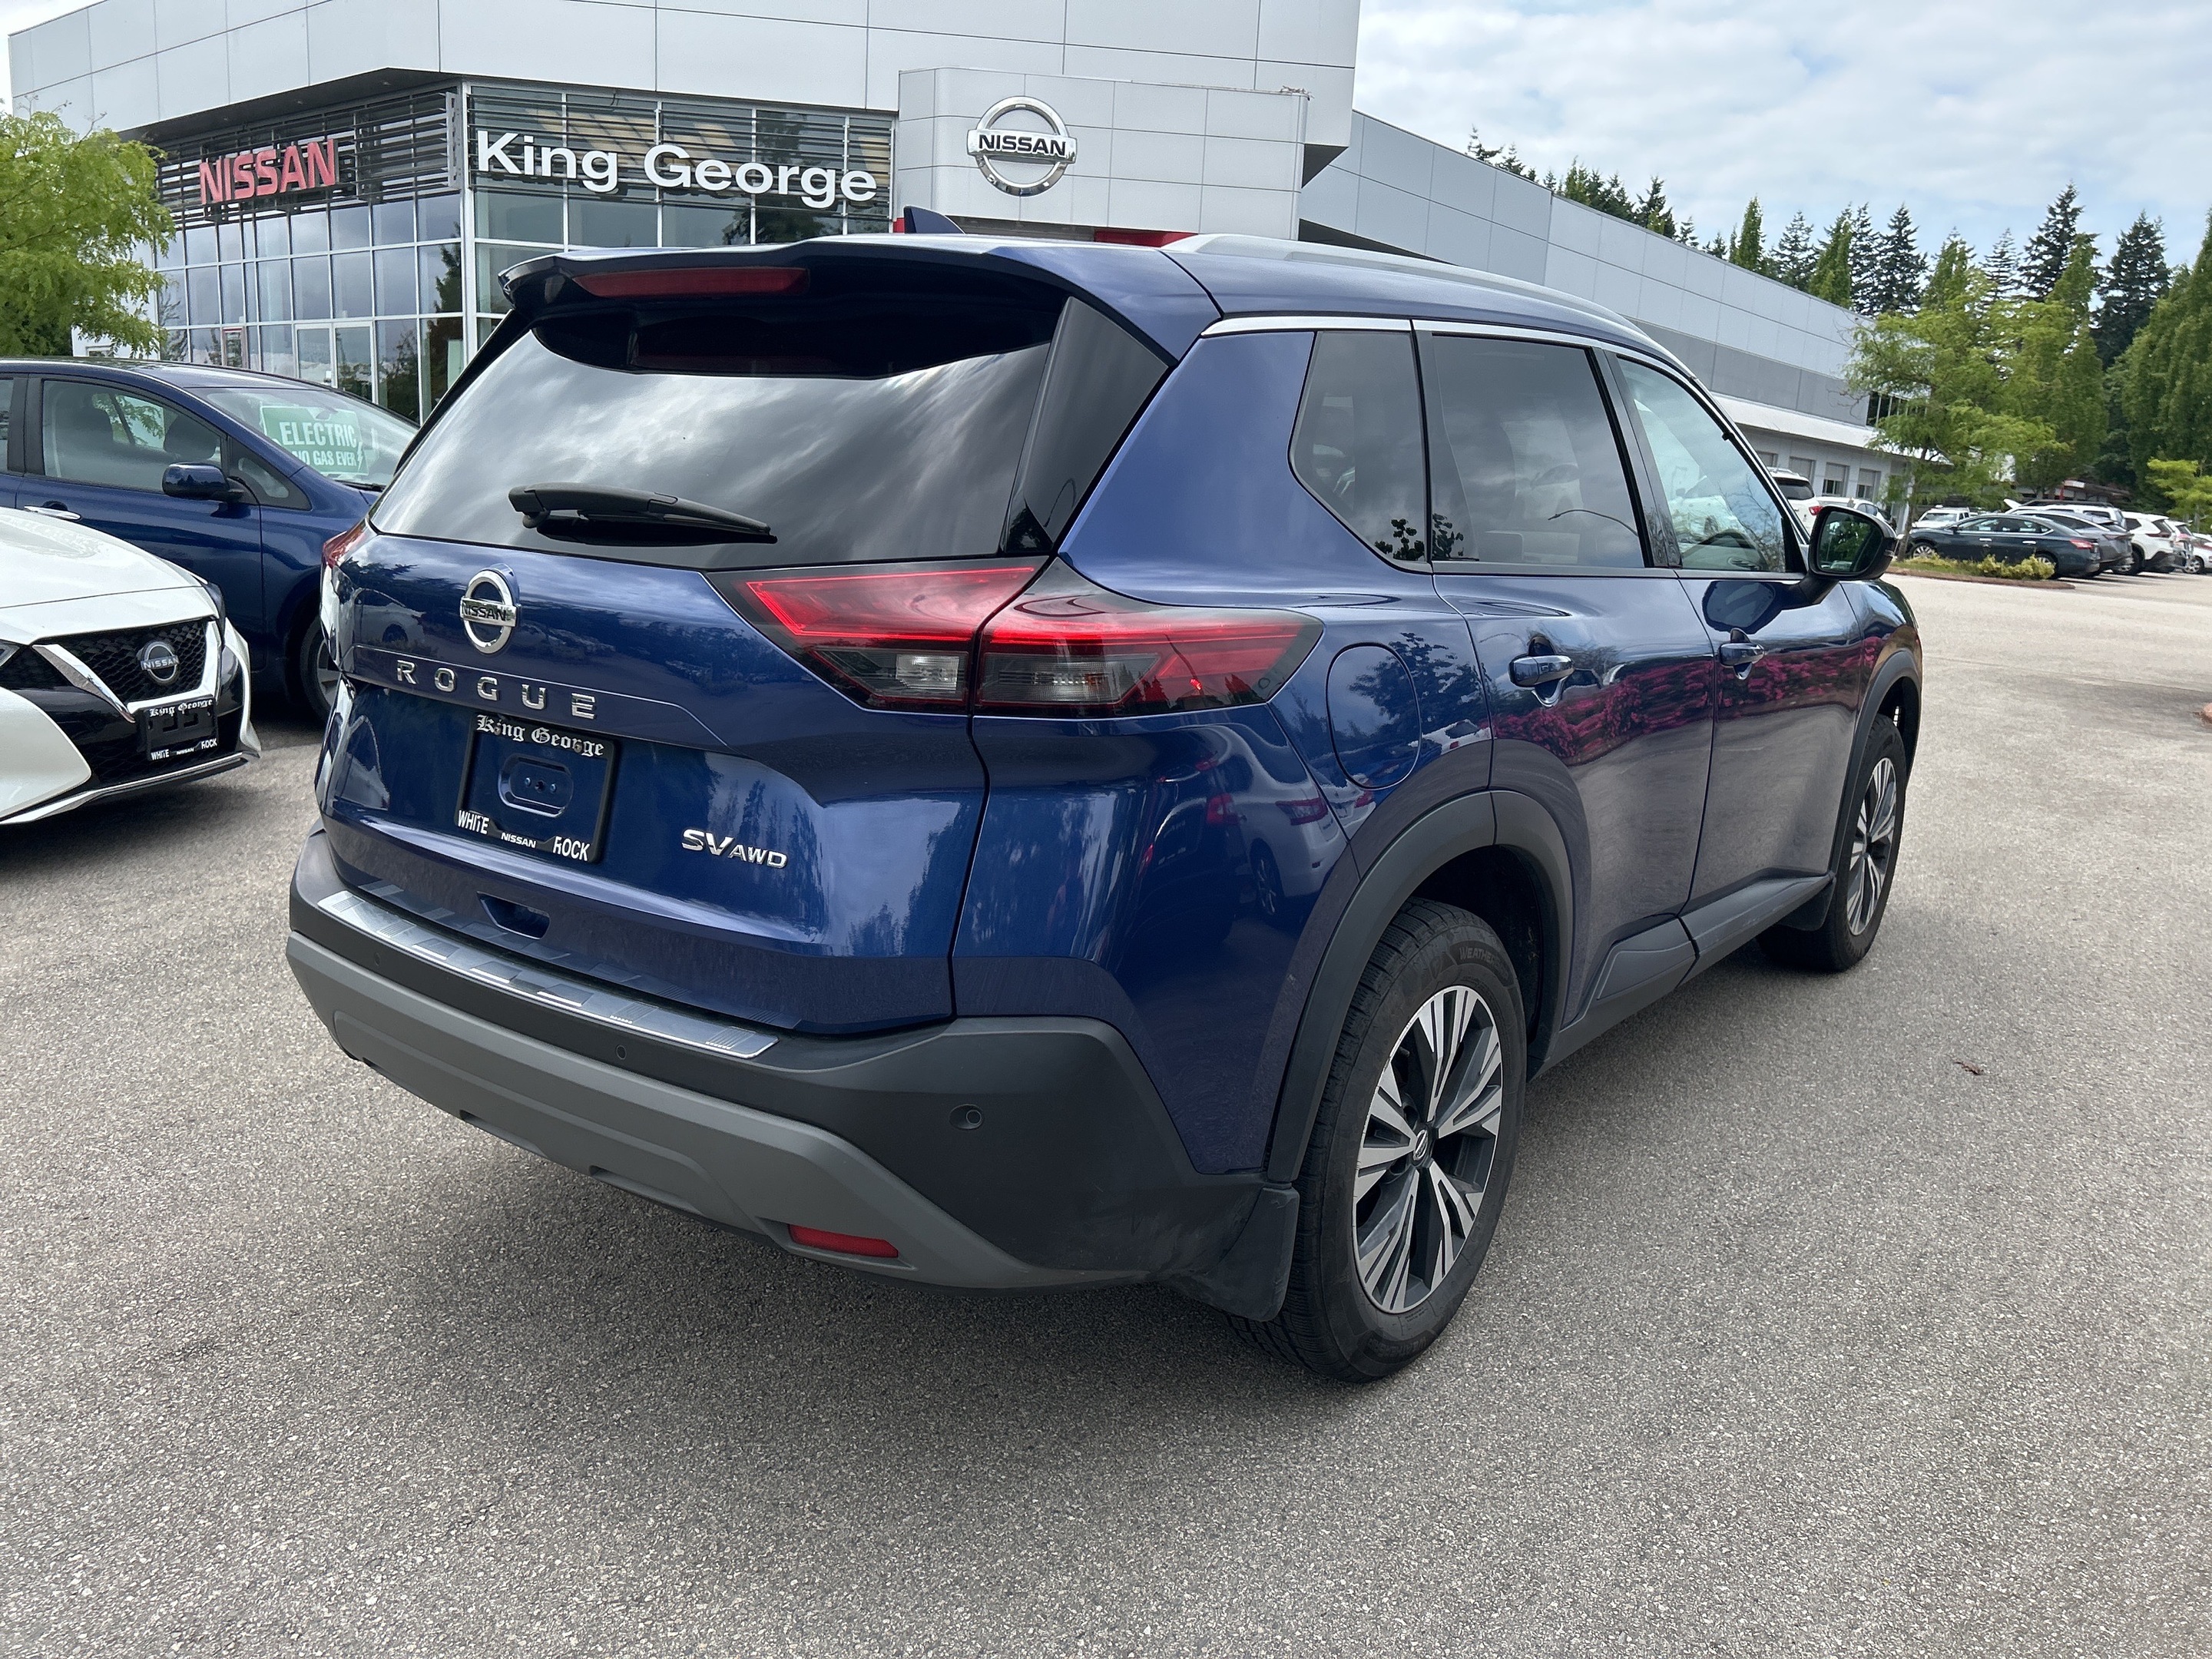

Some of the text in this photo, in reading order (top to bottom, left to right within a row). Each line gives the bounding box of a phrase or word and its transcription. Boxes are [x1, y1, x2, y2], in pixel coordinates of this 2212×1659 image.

[979, 134, 1066, 157] NISSAN
[199, 138, 336, 205] NISSAN
[477, 130, 877, 209] King George
[279, 421, 357, 448] ELECTRIC
[313, 450, 335, 466] GAS
[336, 451, 357, 466] EVER
[462, 603, 506, 621] NISSAN
[143, 658, 178, 669] NISSAN
[396, 660, 596, 719] ROGUE
[149, 707, 176, 717] King
[151, 749, 169, 760] WHITE
[201, 738, 217, 749] ROCK
[476, 714, 604, 757] King George
[458, 810, 591, 862] WHITE NISSAN ROCK
[682, 829, 786, 869] SV AWD
